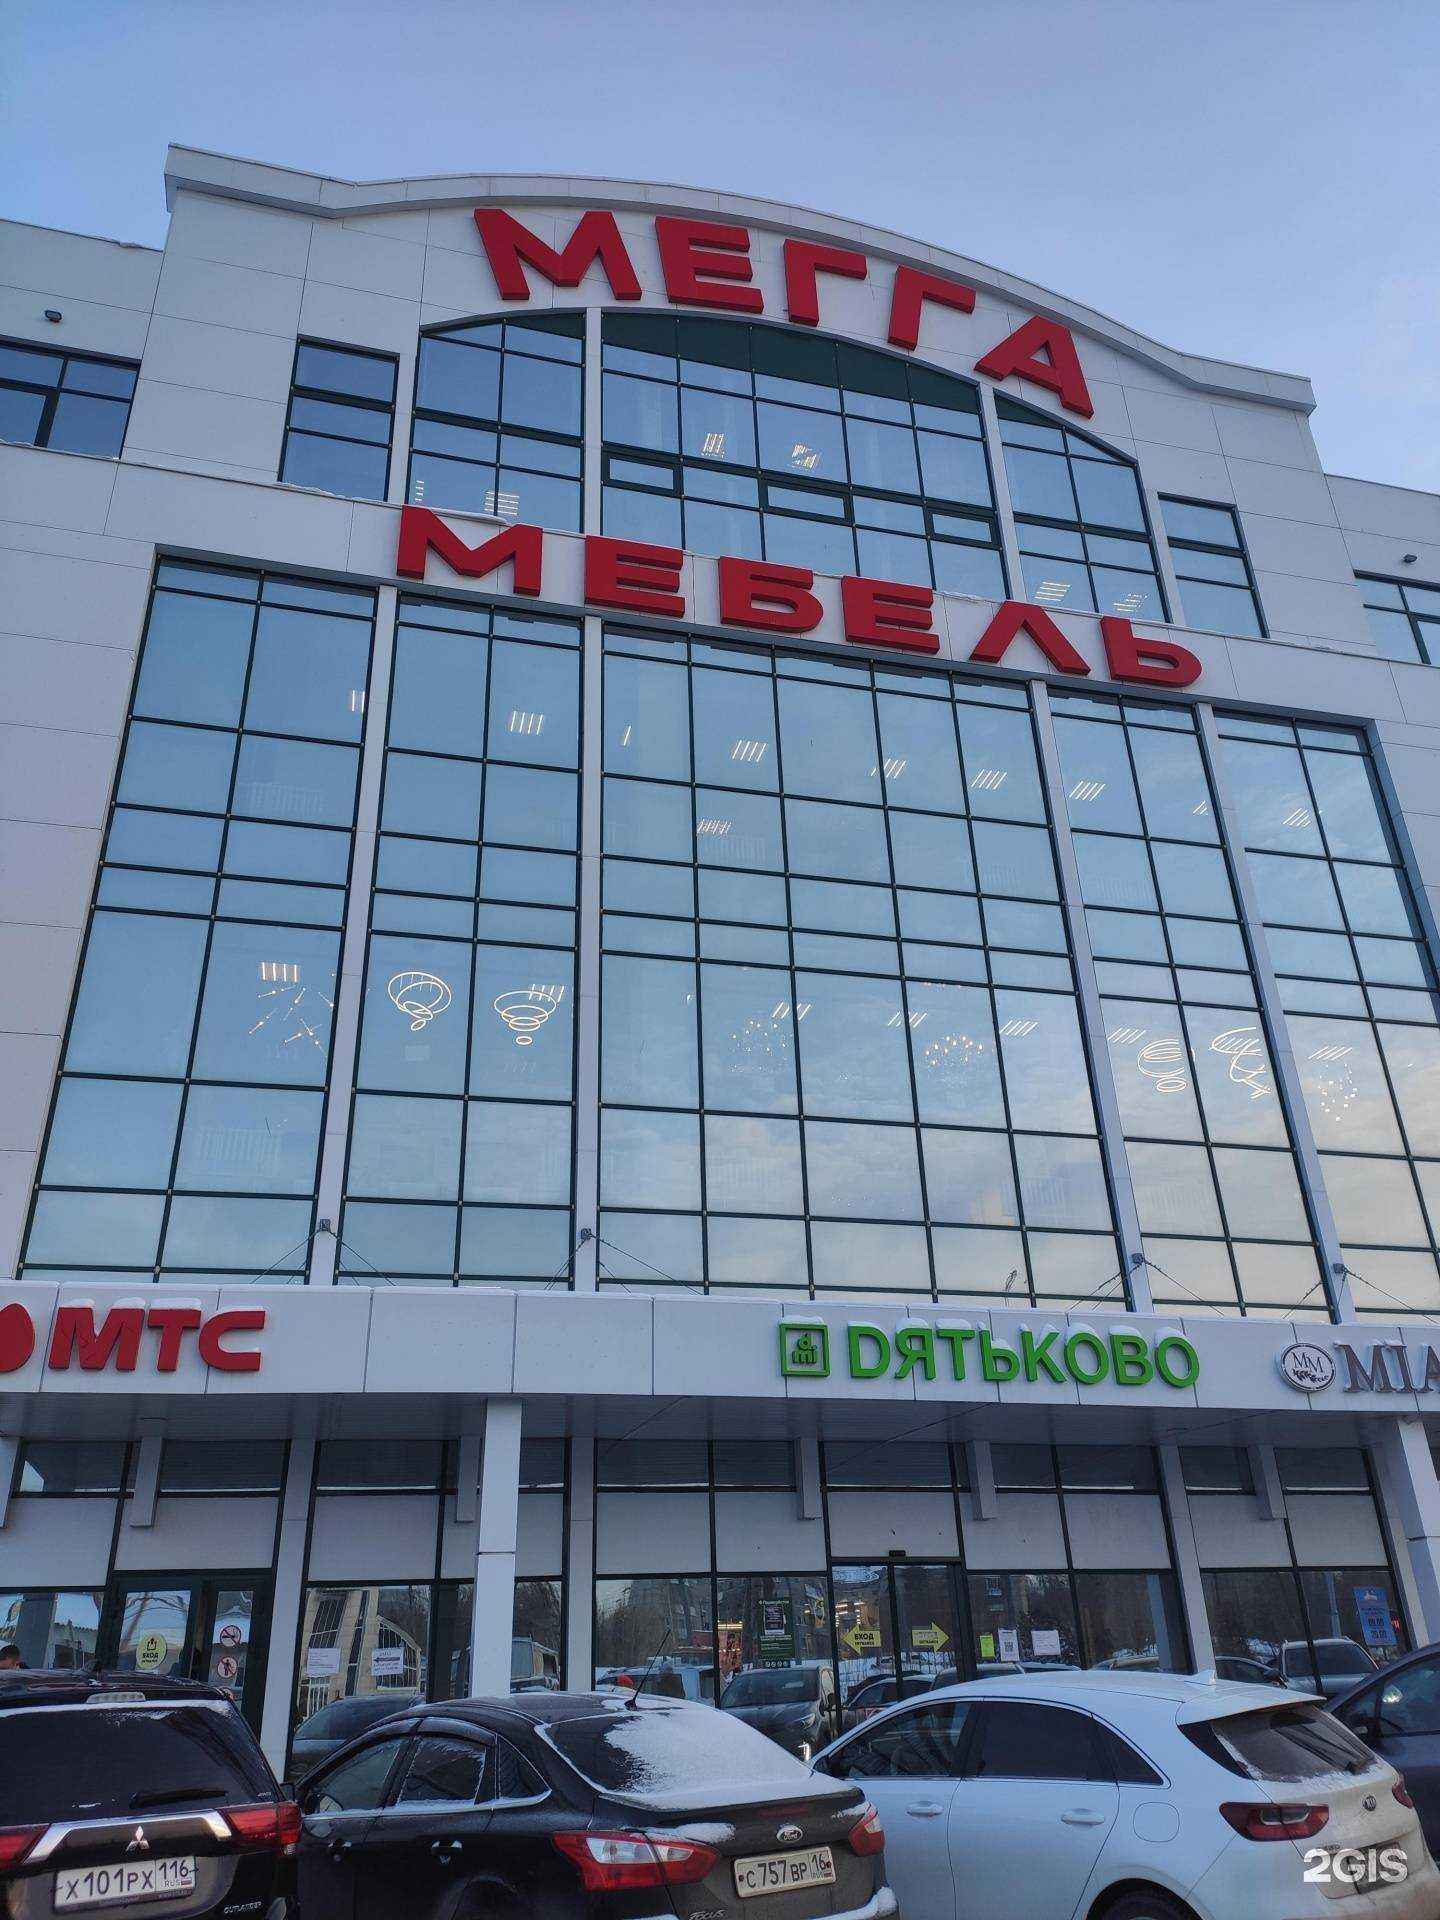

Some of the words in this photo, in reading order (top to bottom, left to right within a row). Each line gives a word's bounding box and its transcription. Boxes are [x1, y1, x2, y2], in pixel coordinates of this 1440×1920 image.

[475, 207, 1091, 416] МЕГГА
[397, 506, 1202, 686] МЕБЕЛЬ
[48, 1306, 266, 1372] МТС
[159, 1860, 189, 1880] 116
